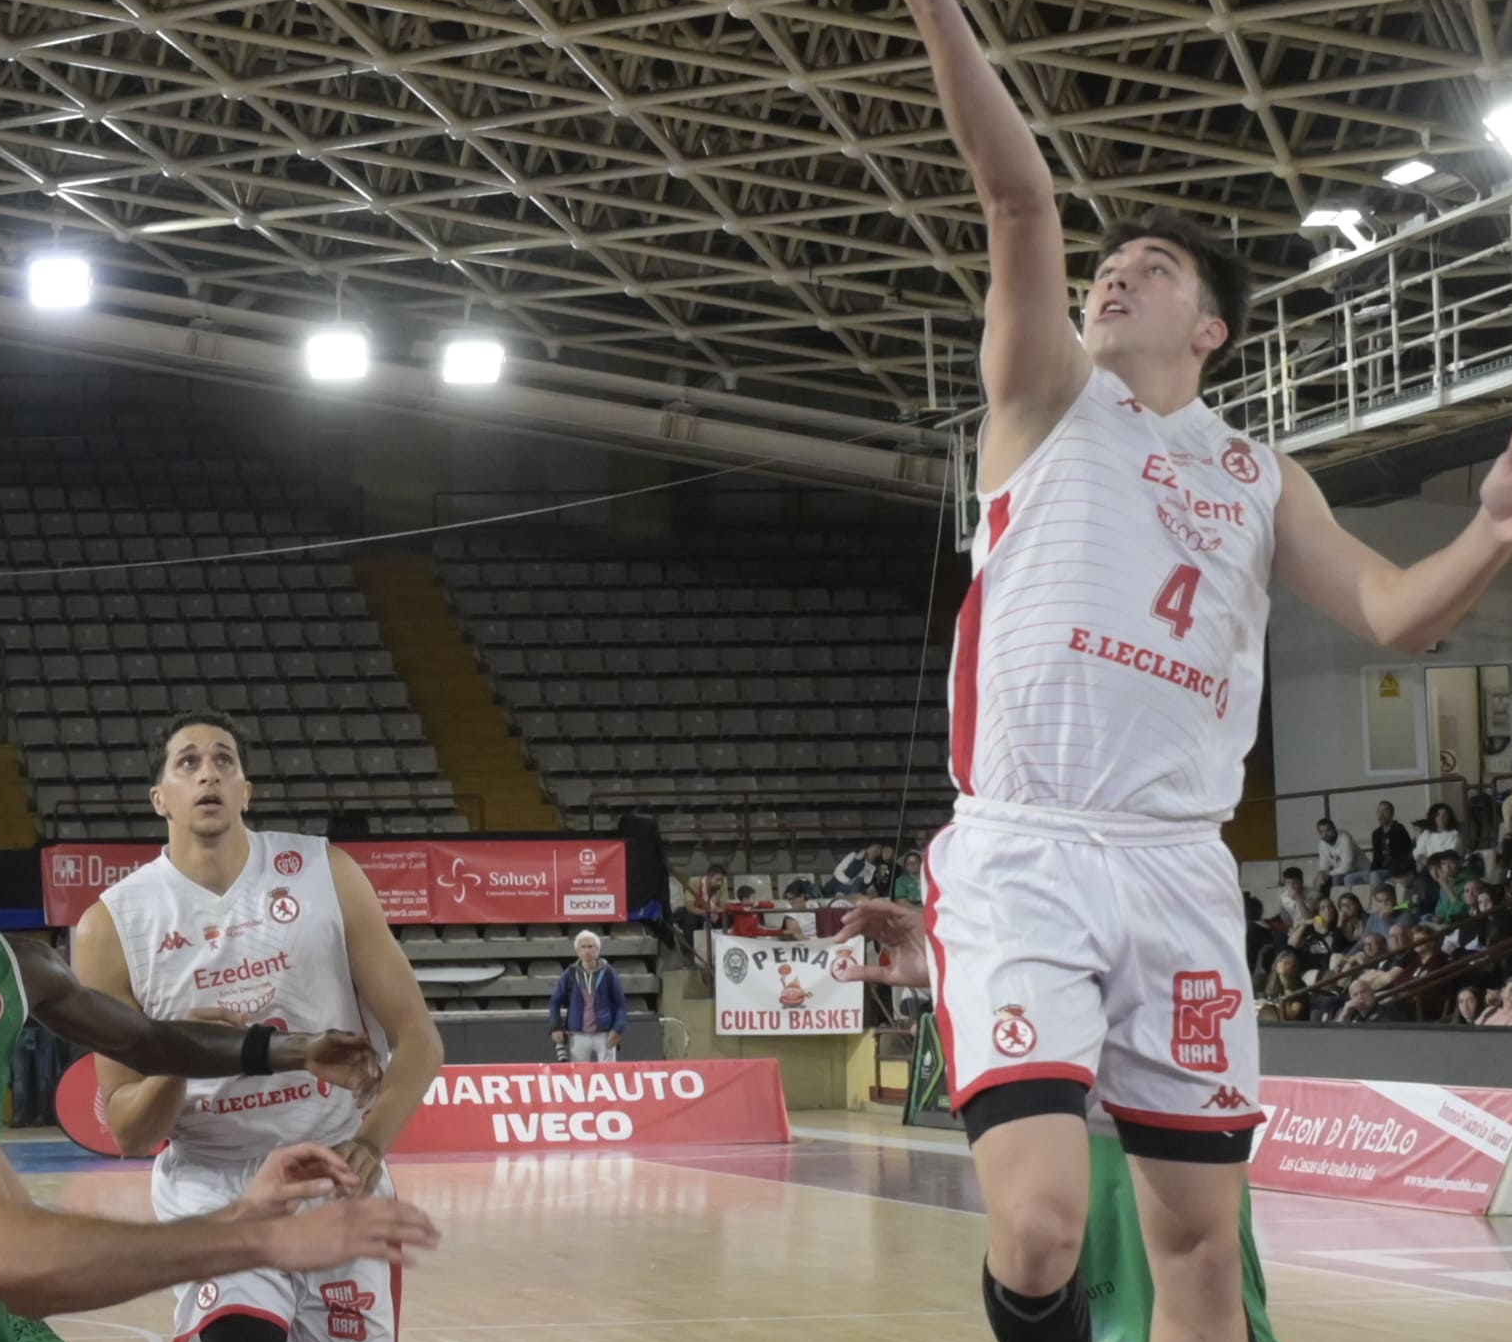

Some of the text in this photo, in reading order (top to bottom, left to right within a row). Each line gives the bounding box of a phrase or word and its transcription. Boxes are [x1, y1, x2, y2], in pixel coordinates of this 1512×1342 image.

[1151, 564, 1202, 641] 4
[1068, 627, 1214, 699] E.LECLERC
[488, 872, 547, 889] Solucyl
[570, 899, 611, 910] brother
[193, 951, 291, 990] Ezedent
[752, 944, 830, 970] PEÑA
[721, 1010, 861, 1030] CULTU BASKET
[492, 1111, 633, 1143] IVECO
